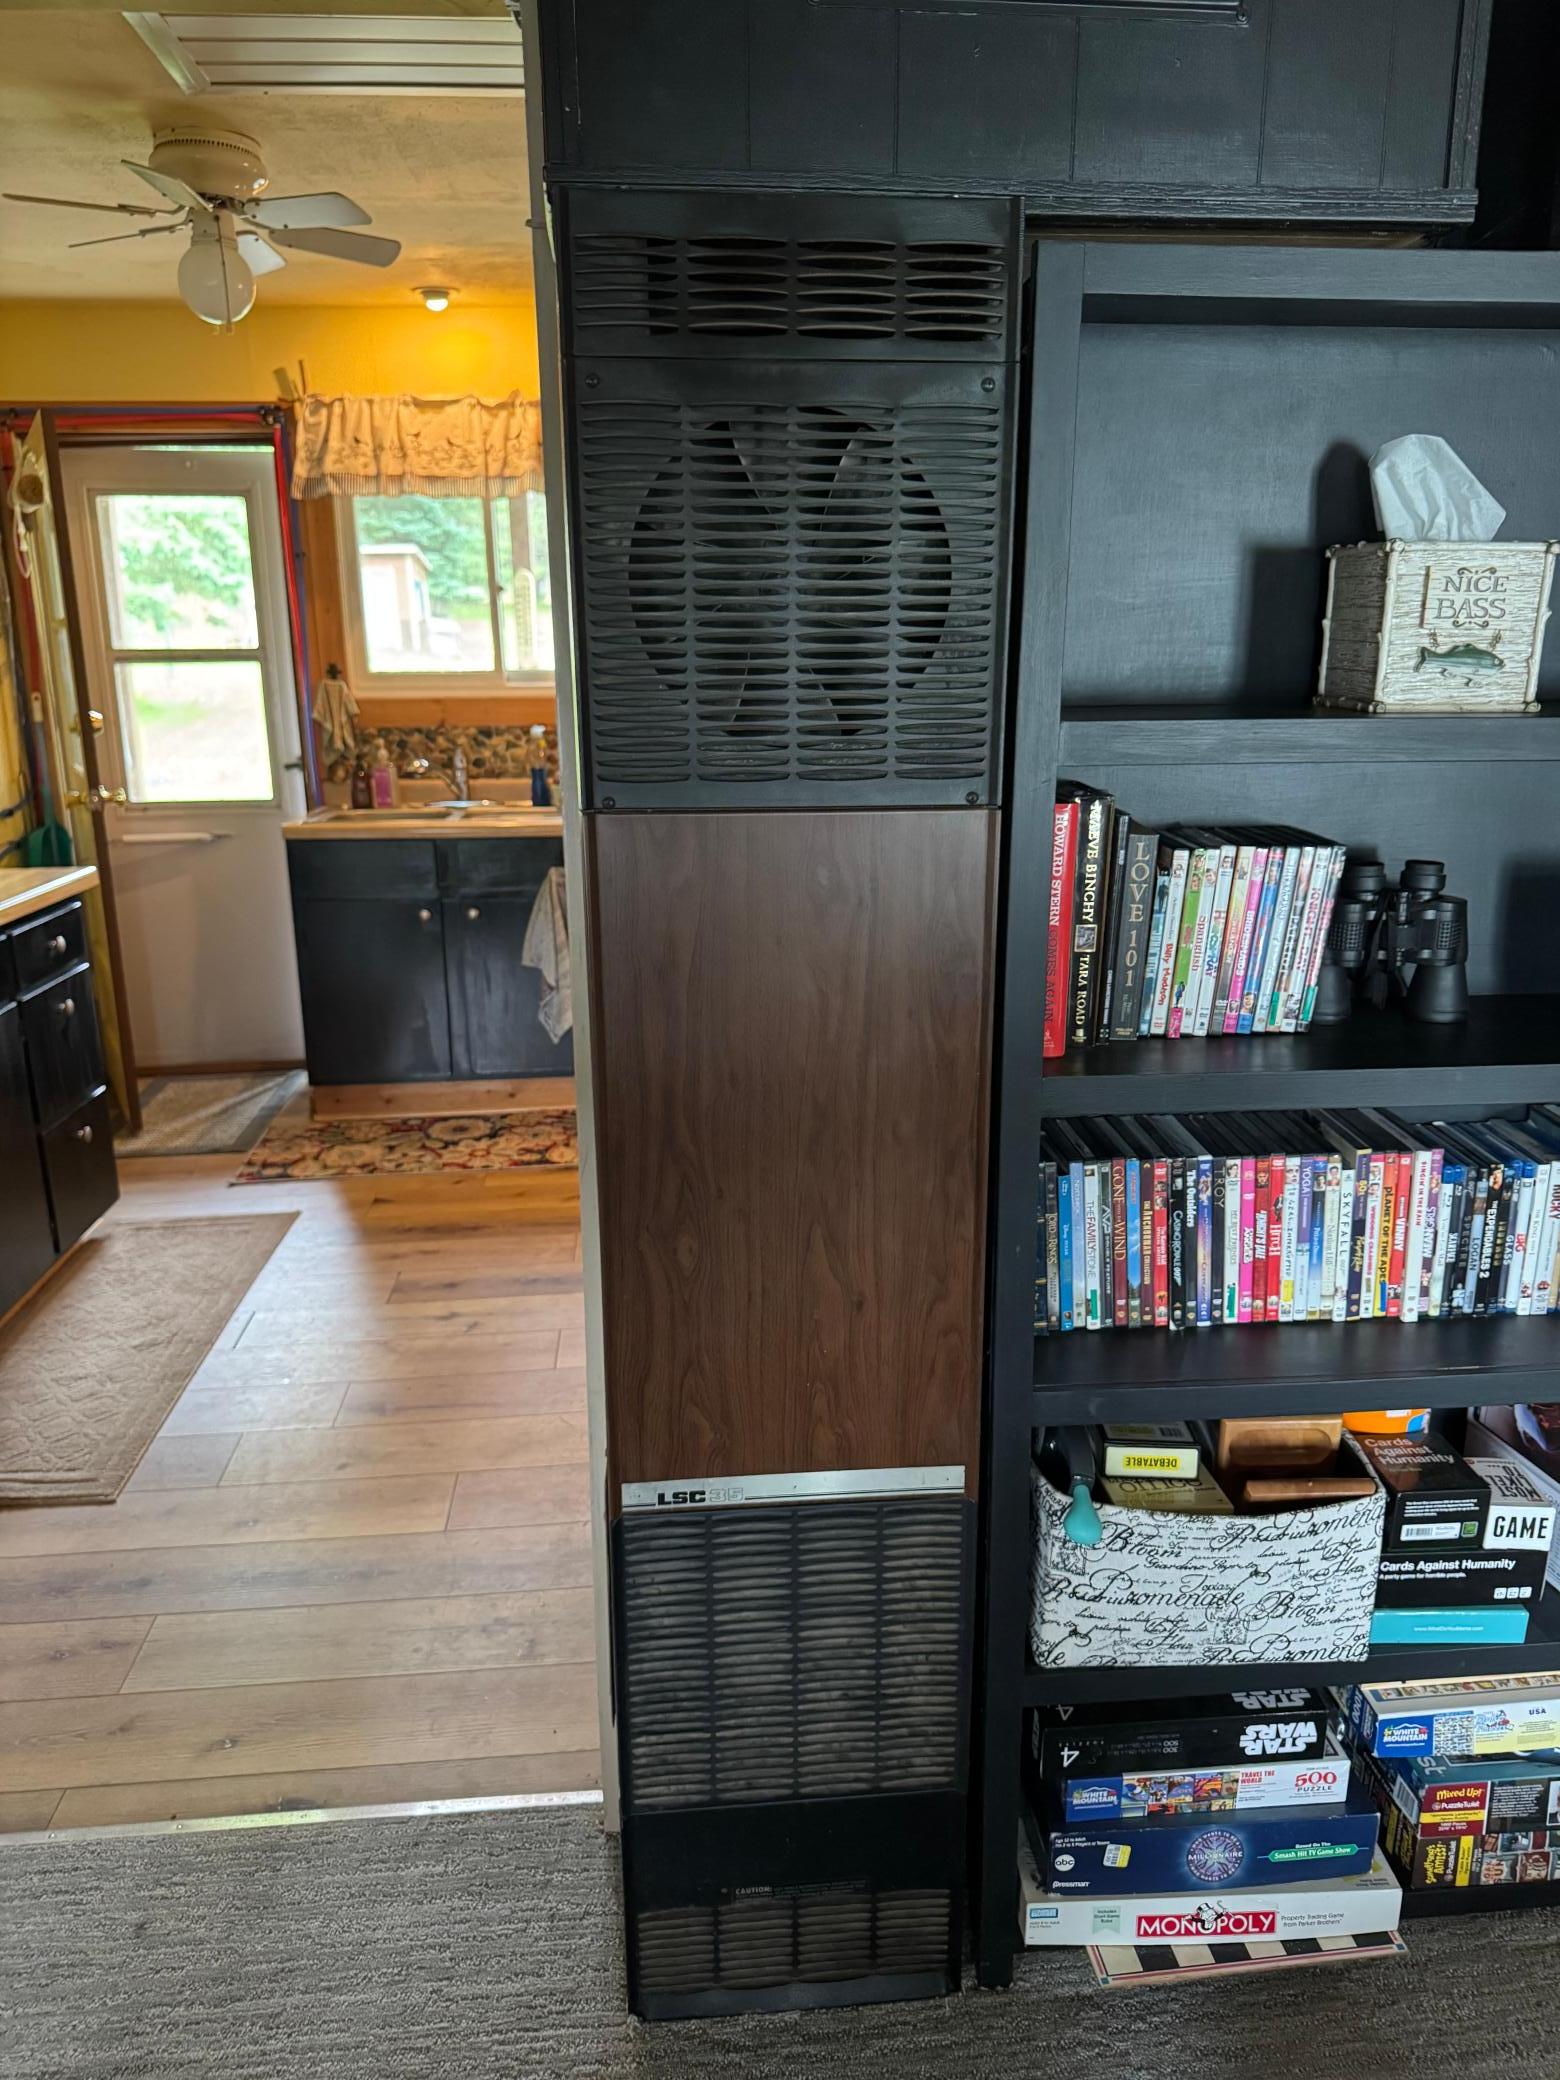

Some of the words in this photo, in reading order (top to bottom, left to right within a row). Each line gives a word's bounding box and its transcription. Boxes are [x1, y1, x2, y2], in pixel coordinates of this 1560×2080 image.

[1443, 576, 1509, 593] NICE
[1436, 597, 1506, 620] BASS
[1053, 813, 1069, 876] HOWARD
[1129, 842, 1150, 922] LOVE
[1050, 880, 1062, 926] STERN
[1083, 864, 1097, 922] BINCHY
[1047, 930, 1058, 977] COMES
[1163, 942, 1174, 964] Billy
[1192, 915, 1207, 972] Spanglish
[1079, 954, 1091, 986] TARA
[1158, 967, 1172, 1006] Madison
[1044, 980, 1056, 1024] AGAIN
[1076, 991, 1086, 1026] ROAD
[1113, 1166, 1125, 1205] GONE
[1188, 1170, 1196, 1187] The
[1215, 1166, 1225, 1208] TROY
[1302, 1166, 1311, 1194] YOGA
[1187, 1188, 1197, 1227] Outsiders
[1415, 1209, 1423, 1227] RAIN
[1340, 1192, 1352, 1257] SKYFALL
[1383, 1225, 1391, 1237] OF
[1395, 1217, 1406, 1251] VINNY
[1114, 1221, 1126, 1261] WIND
[1381, 1239, 1390, 1258] THE
[1459, 1215, 1472, 1268] SPECTRE
[1481, 1208, 1496, 1271] EXPENDABLES
[1504, 1234, 1514, 1266] GLASS
[1516, 1232, 1526, 1253] BIG
[1469, 1237, 1481, 1271] LOGAN
[1478, 1270, 1490, 1279] 2
[1364, 1437, 1413, 1448] Cards
[1373, 1445, 1433, 1457] Against
[1125, 1456, 1178, 1468] DEBATABLE
[1378, 1453, 1455, 1465] Humanity
[1484, 1475, 1532, 1491] LIKEL
[657, 1490, 706, 1506] LSC
[708, 1487, 745, 1503] 35
[1499, 1489, 1544, 1502] MOST
[1493, 1515, 1550, 1539] GAME
[1380, 1561, 1415, 1572] Cards
[1416, 1559, 1460, 1572] Against
[1461, 1558, 1516, 1571] Humanity
[1231, 1692, 1311, 1710] STAR
[1528, 1707, 1547, 1716] USA
[1245, 1721, 1318, 1741] WARS
[1383, 1733, 1428, 1743] MOUNTAIN
[1393, 1727, 1420, 1736] WHITE
[1239, 1735, 1318, 1756] STAR
[1060, 1746, 1080, 1768] 4
[1295, 1771, 1338, 1788] 500
[1296, 1785, 1332, 1793] PUZZLE
[1072, 1796, 1117, 1805] MOUNTAIN
[1435, 1788, 1466, 1801] Mixed
[1466, 1787, 1482, 1799] Up!
[1055, 1858, 1074, 1866] abc
[1274, 1851, 1296, 1860] Smash
[1297, 1850, 1308, 1858] Hit
[1308, 1849, 1317, 1857] TV
[1317, 1848, 1334, 1857] Game
[1334, 1847, 1351, 1855] Show
[1139, 1914, 1274, 1936] MONOPOLY
[1281, 1914, 1306, 1923] Property
[1307, 1913, 1328, 1921] Trading
